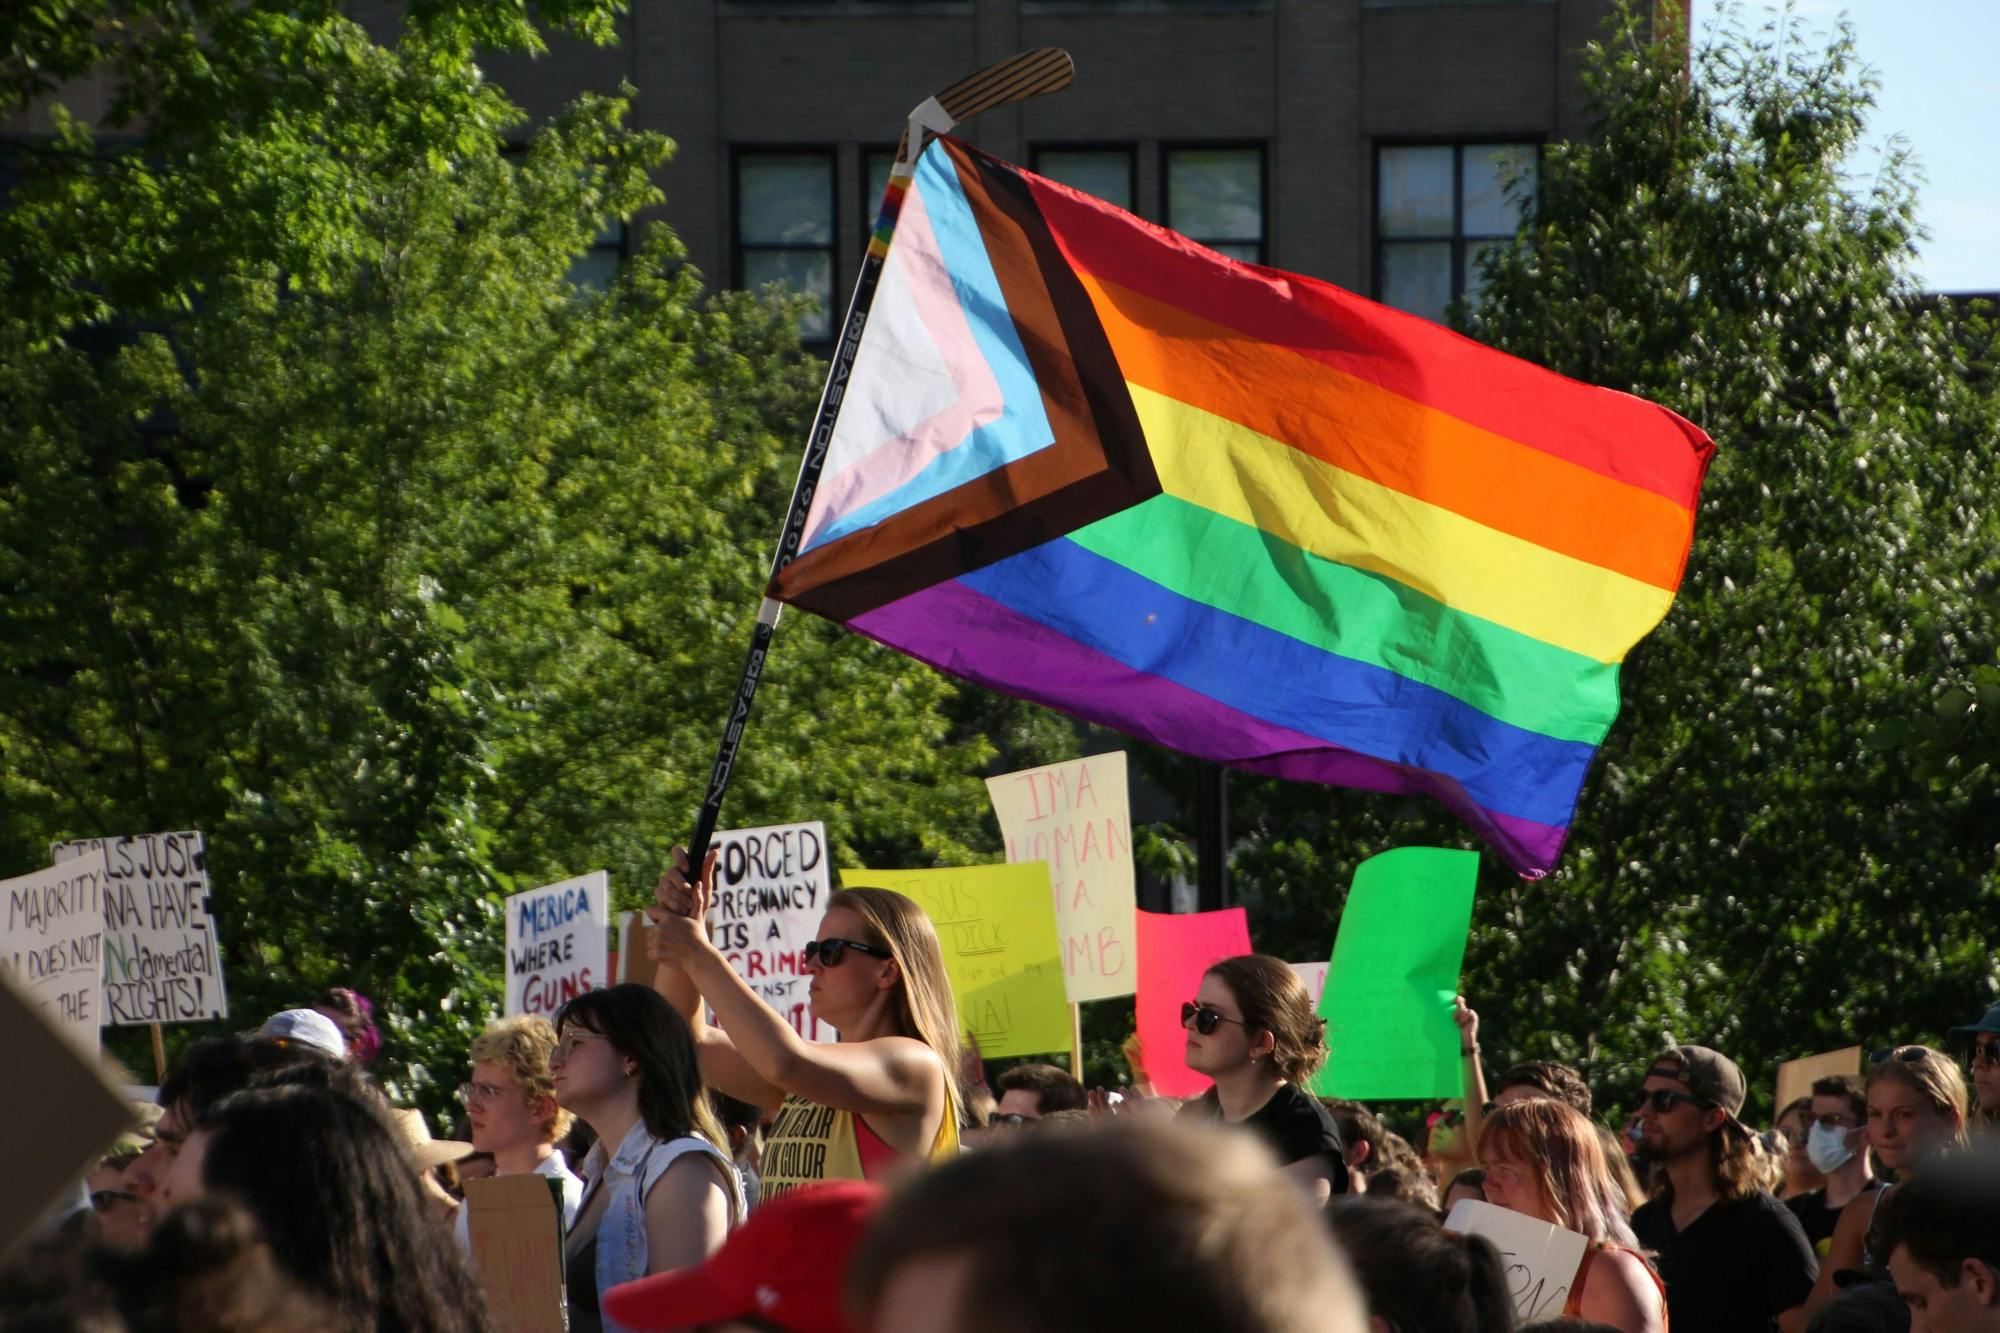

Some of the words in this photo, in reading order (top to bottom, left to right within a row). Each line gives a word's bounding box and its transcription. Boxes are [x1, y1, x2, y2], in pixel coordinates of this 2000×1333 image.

[808, 339, 857, 470] EASTON
[707, 675, 756, 807] EASTON
[138, 834, 196, 879] JUST
[709, 829, 820, 891] FORCED
[9, 869, 100, 935] MAJORITY
[147, 882, 205, 930] HAVE
[29, 939, 66, 979] DOES
[70, 932, 101, 967] NOT
[511, 932, 574, 974] WHERE
[714, 922, 749, 951] IS
[766, 918, 781, 941] A
[57, 988, 89, 1024] THE
[107, 976, 204, 1026] RIGHTS!
[523, 967, 591, 1014] GUNS
[780, 1142, 827, 1179] COLOR
